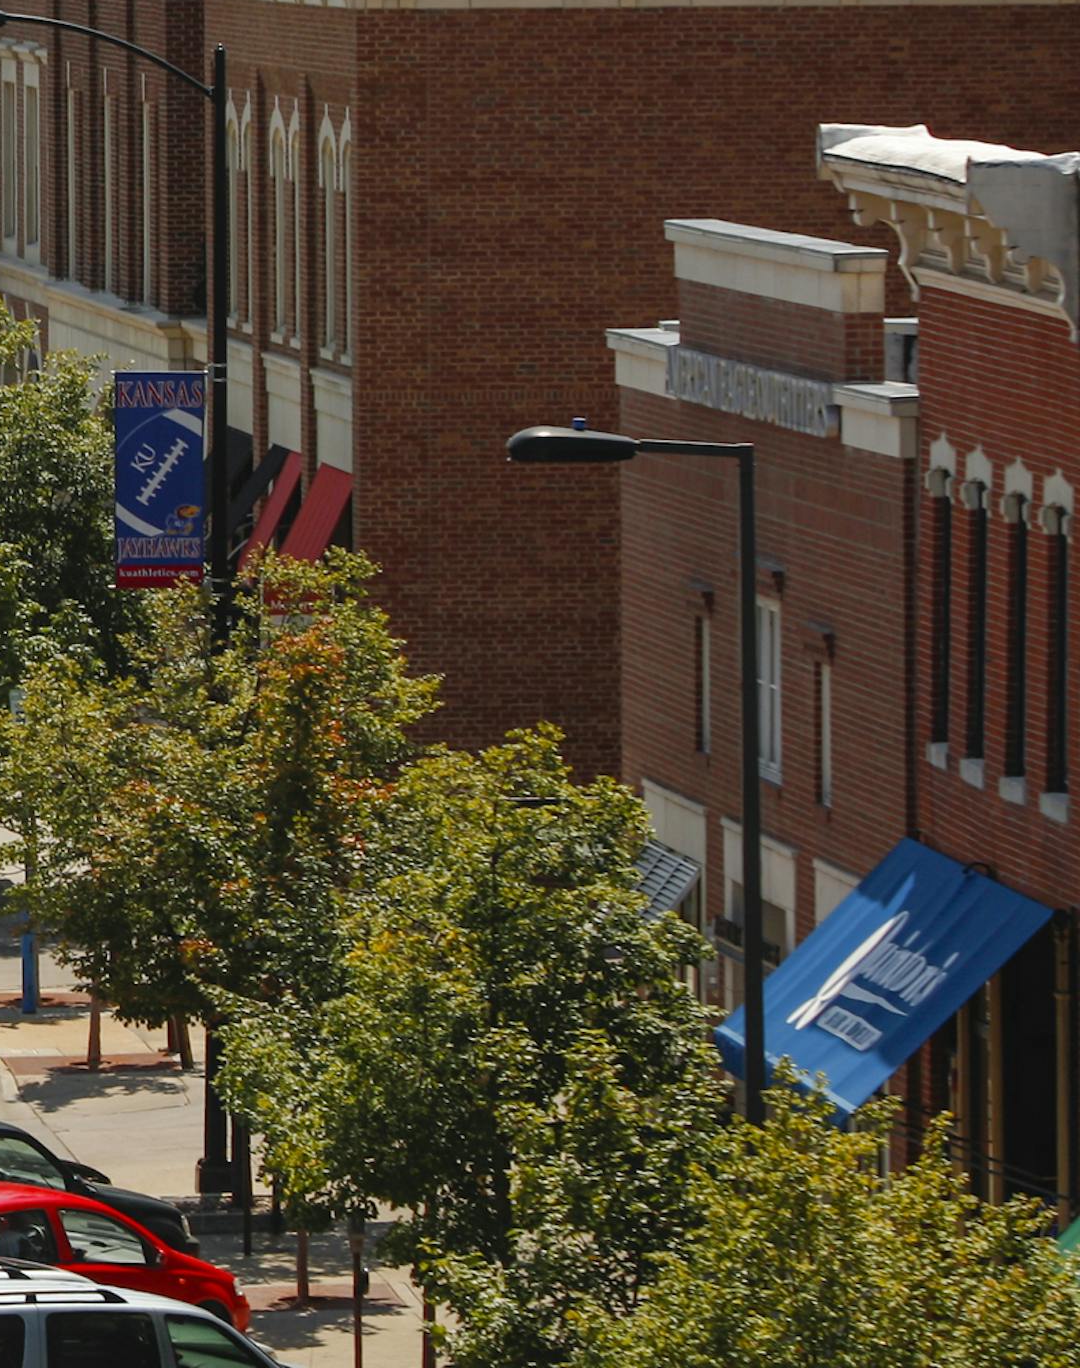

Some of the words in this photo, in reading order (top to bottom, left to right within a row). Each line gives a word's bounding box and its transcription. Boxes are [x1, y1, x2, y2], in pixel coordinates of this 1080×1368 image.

[117, 381, 203, 408] KANSAS
[130, 443, 157, 474] KU
[117, 536, 202, 561] JAYHAWKS
